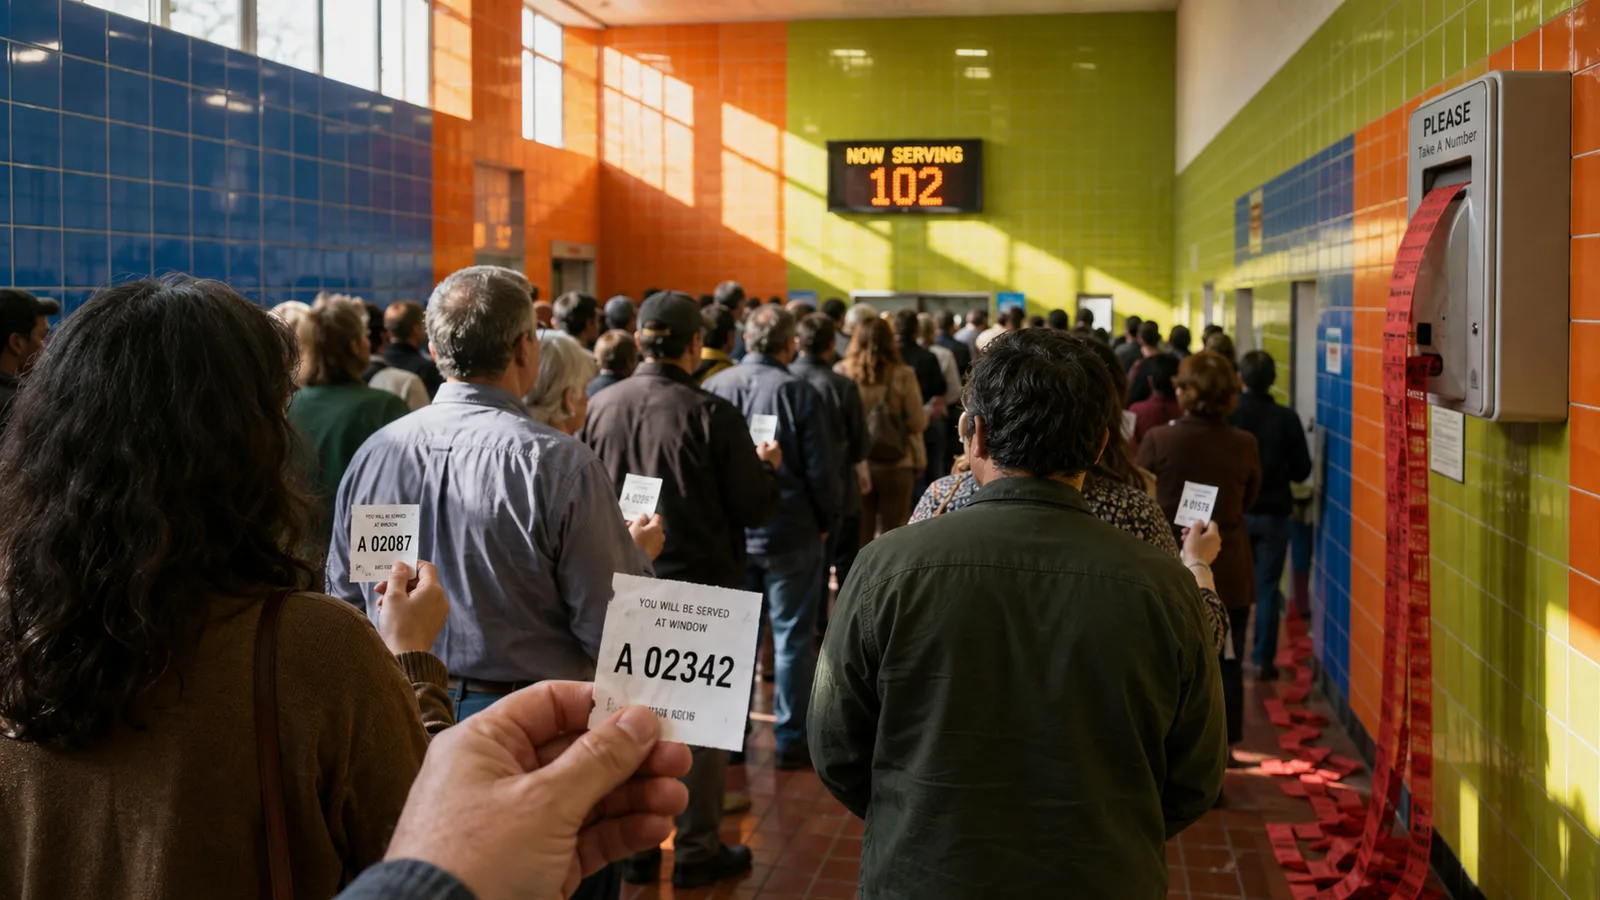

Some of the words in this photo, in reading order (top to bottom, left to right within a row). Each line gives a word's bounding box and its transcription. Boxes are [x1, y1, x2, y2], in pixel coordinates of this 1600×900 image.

[1423, 100, 1471, 137] PLEASE
[1418, 144, 1435, 159] Take
[1437, 140, 1443, 152] A
[1444, 130, 1477, 151] Number
[846, 147, 885, 165] NOW
[891, 146, 964, 164] SERVING
[870, 166, 943, 206] 102
[1183, 499, 1188, 508] A
[357, 536, 367, 552] A
[371, 535, 412, 552] 02087
[639, 598, 657, 609] YOU
[660, 601, 680, 613] WILL
[683, 604, 694, 614] BE
[696, 606, 730, 618] SERVED
[655, 618, 667, 628] AT
[669, 620, 708, 633] WINDOW
[613, 643, 633, 675] A
[644, 646, 735, 689] 02342
